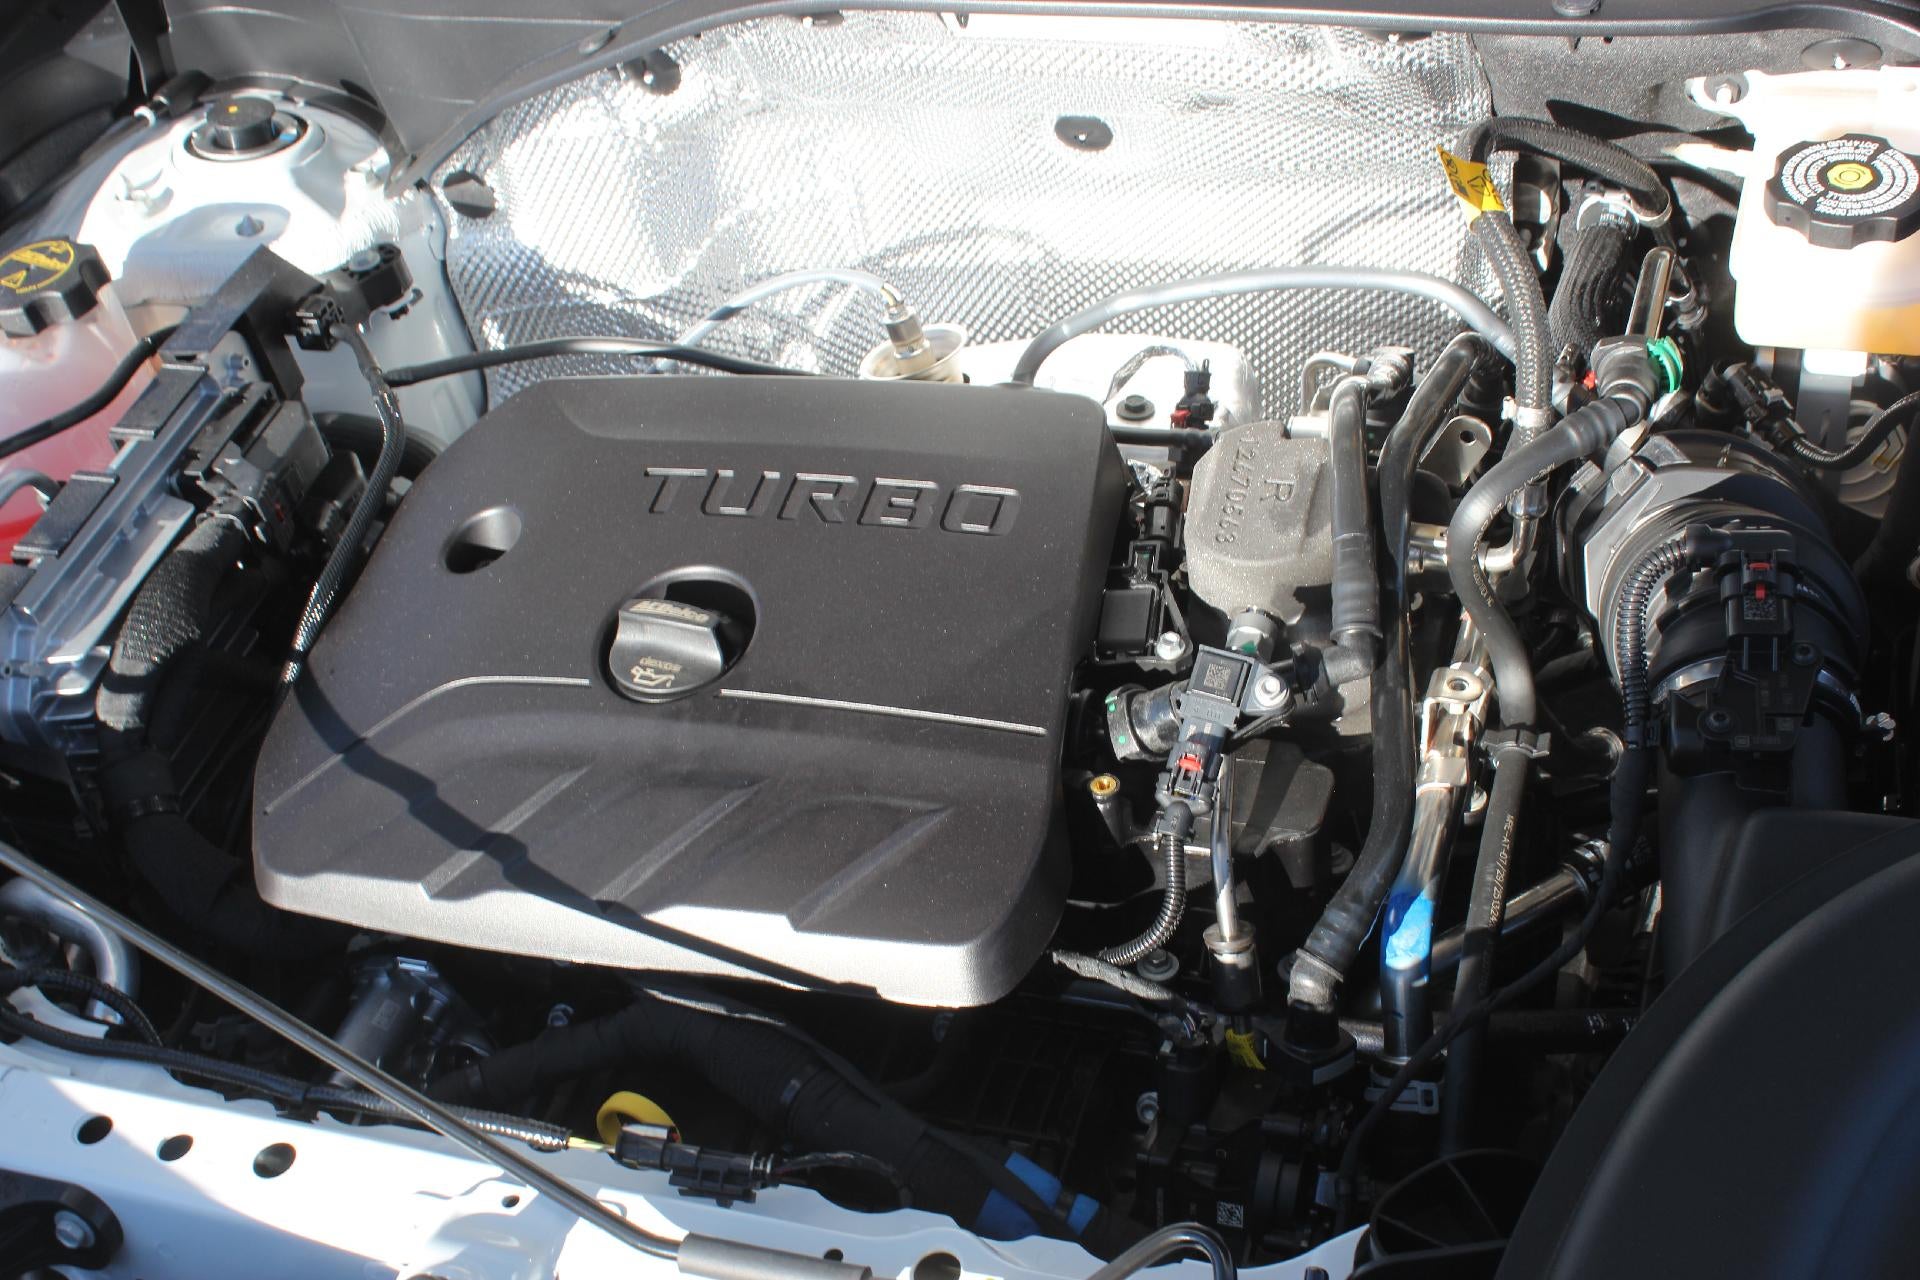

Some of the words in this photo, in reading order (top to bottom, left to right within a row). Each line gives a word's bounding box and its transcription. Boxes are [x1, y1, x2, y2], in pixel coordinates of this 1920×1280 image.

[1827, 140, 1853, 148] FLUID
[1860, 140, 1879, 149] DOT
[1260, 479, 1296, 502] R
[644, 467, 1021, 536] TURBO
